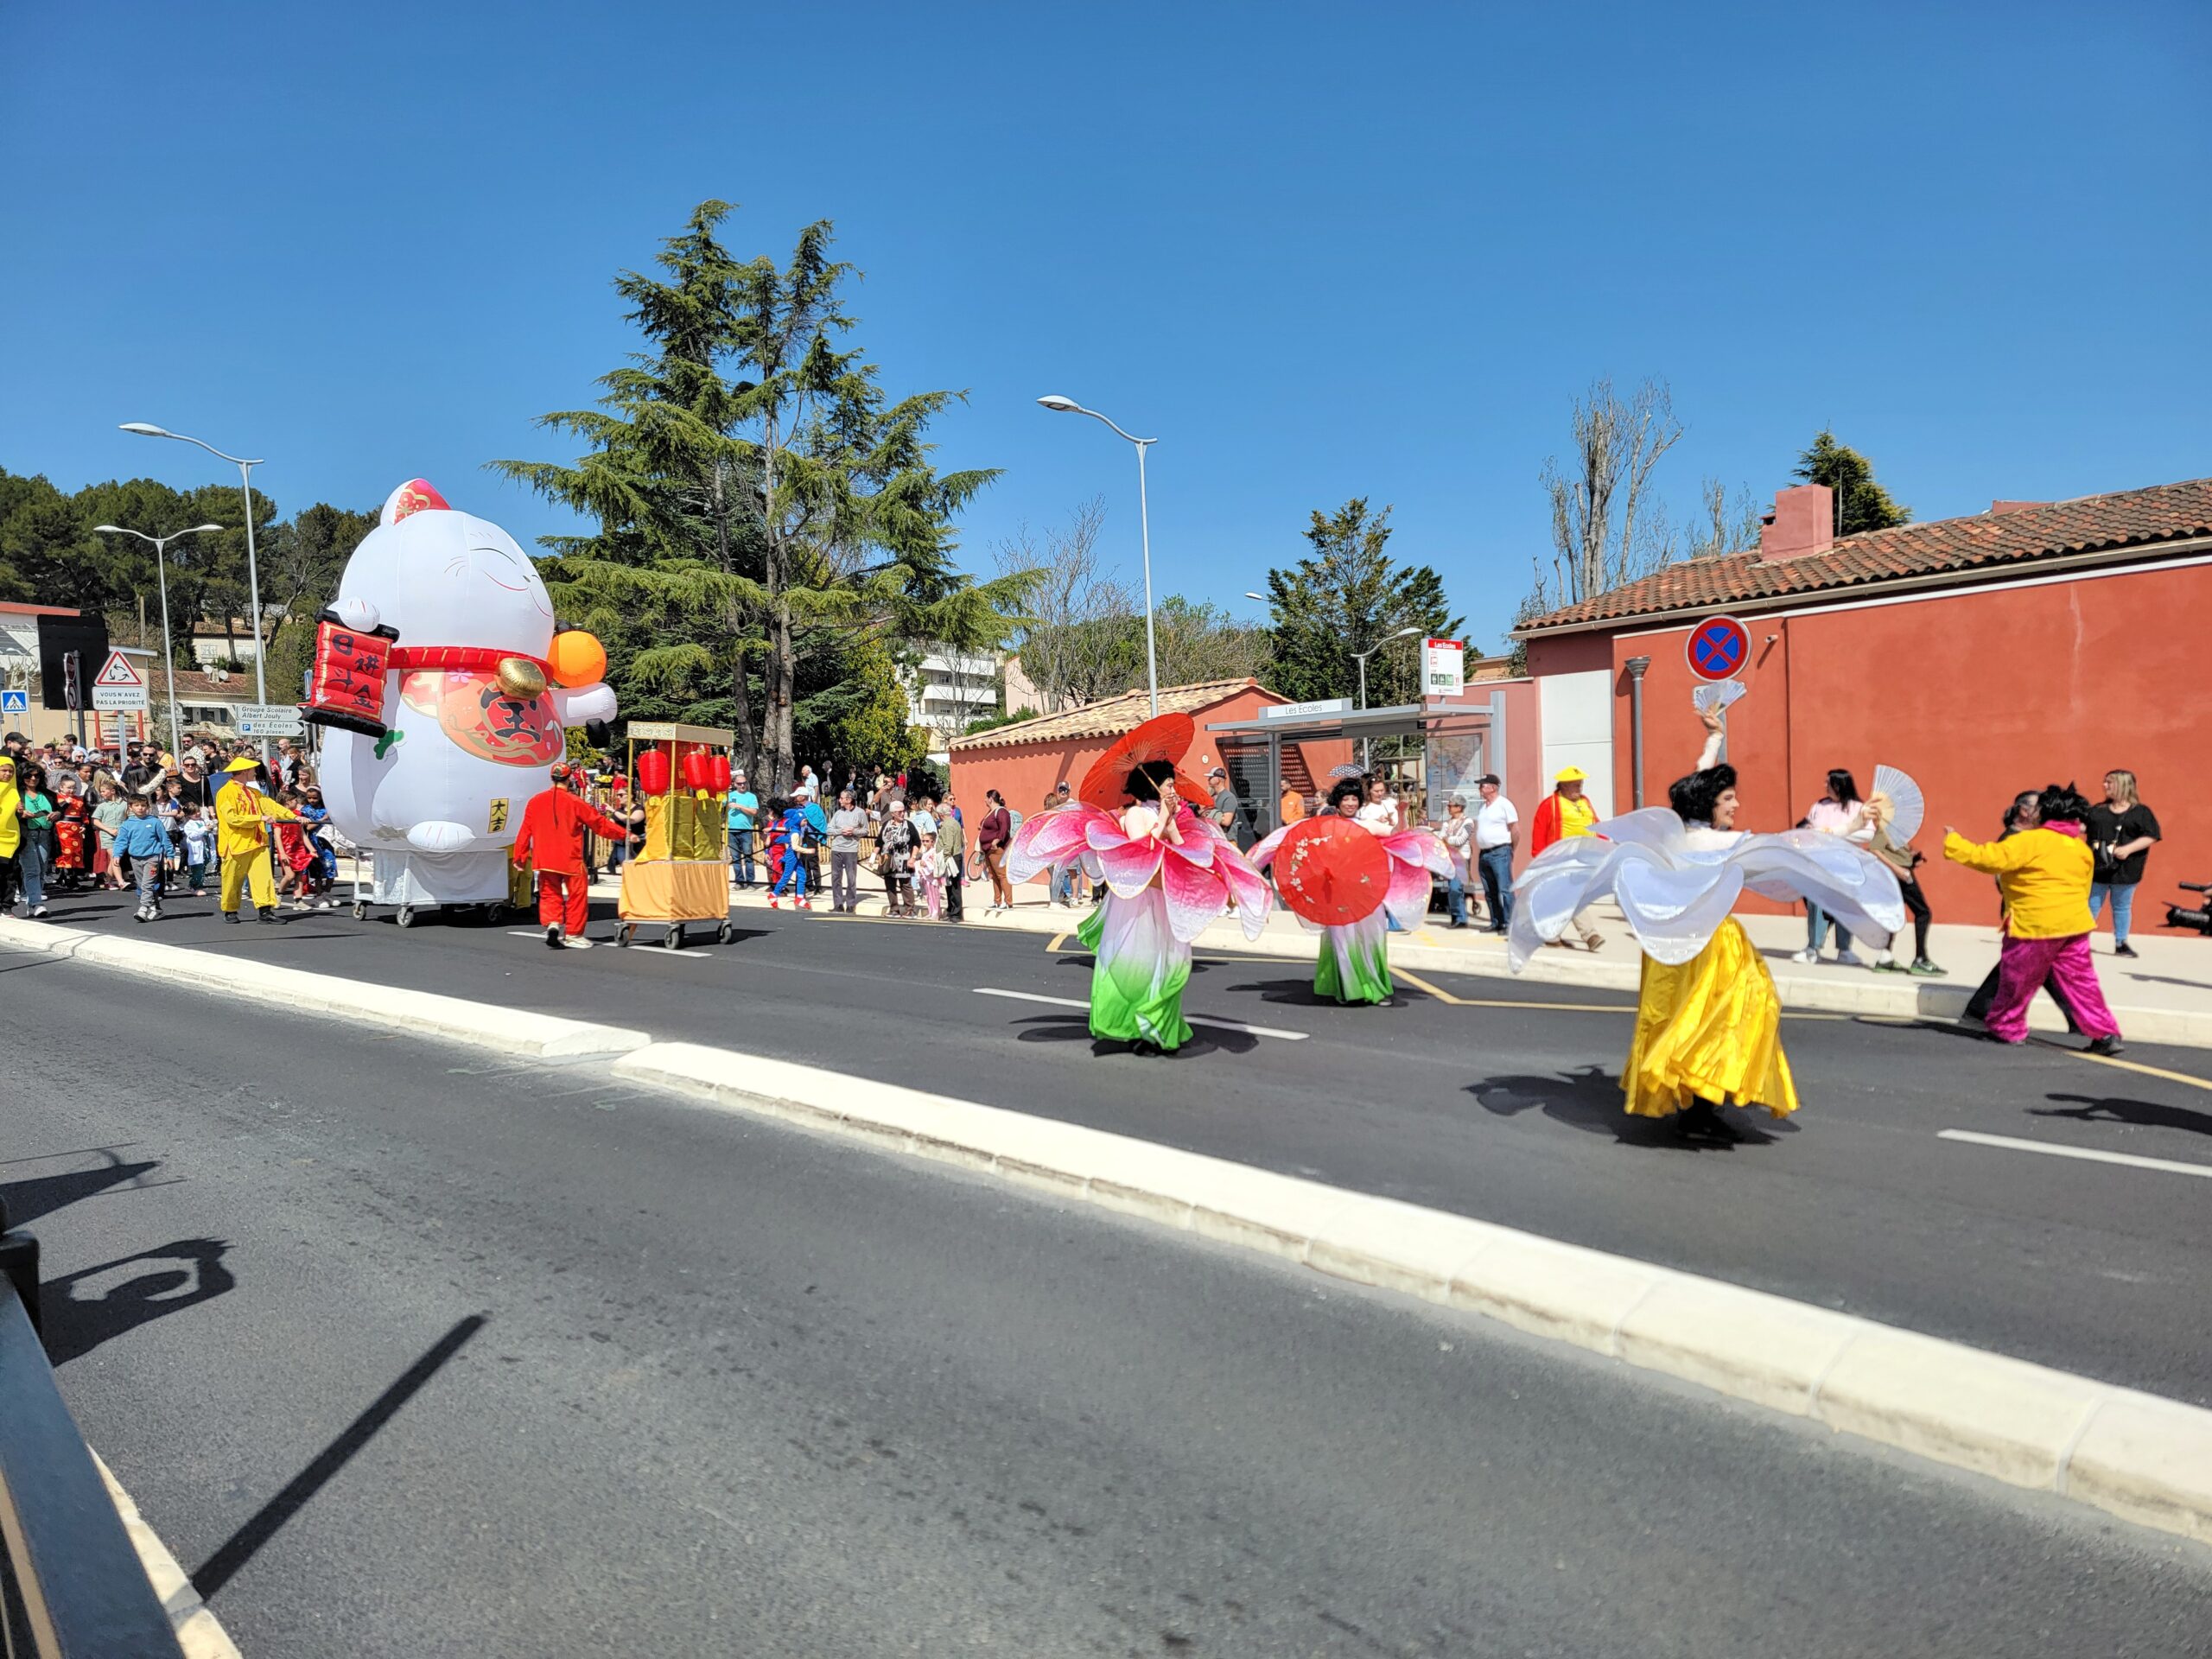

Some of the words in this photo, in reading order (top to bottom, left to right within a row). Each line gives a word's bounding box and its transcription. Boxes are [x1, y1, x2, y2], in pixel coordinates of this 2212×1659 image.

[1285, 706, 1297, 715] Les
[1298, 703, 1323, 714] Ecoles
[491, 800, 507, 832] 大吉
